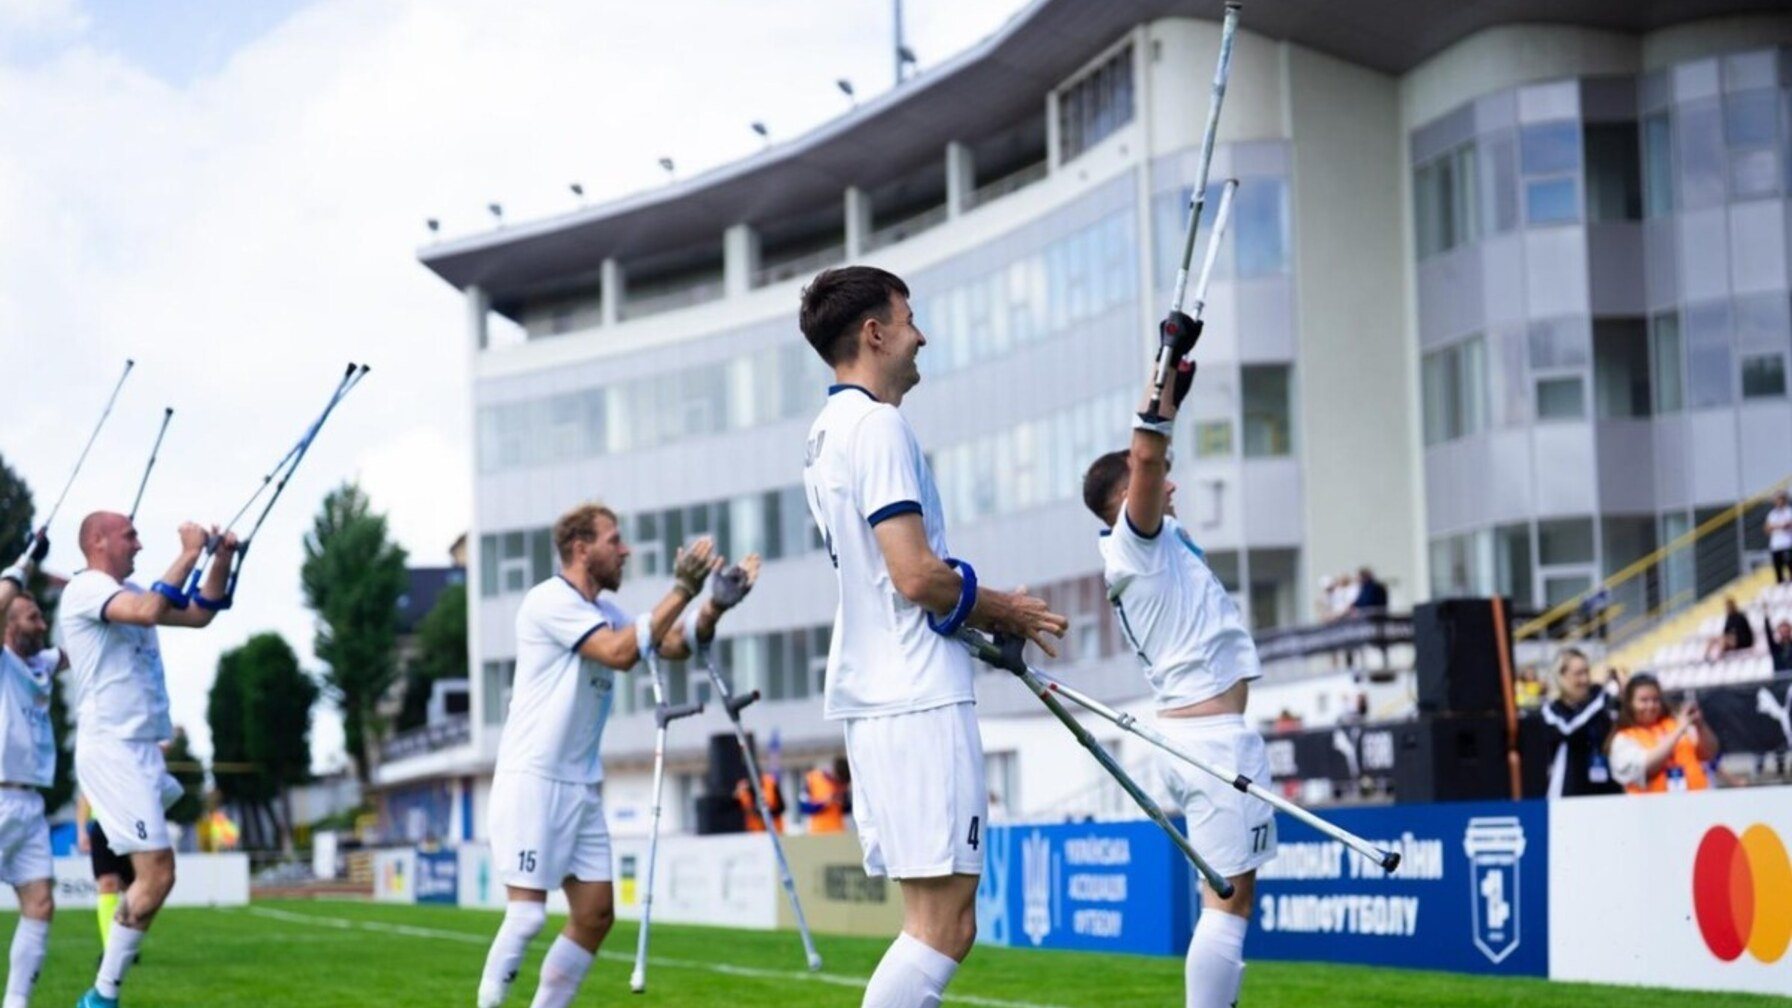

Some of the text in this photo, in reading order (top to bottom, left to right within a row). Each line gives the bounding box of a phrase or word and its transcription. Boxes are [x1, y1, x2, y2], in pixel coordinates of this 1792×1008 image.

[136, 820, 148, 840] 8
[967, 816, 980, 851] 4
[1251, 823, 1269, 854] 77
[518, 849, 538, 874] 15
